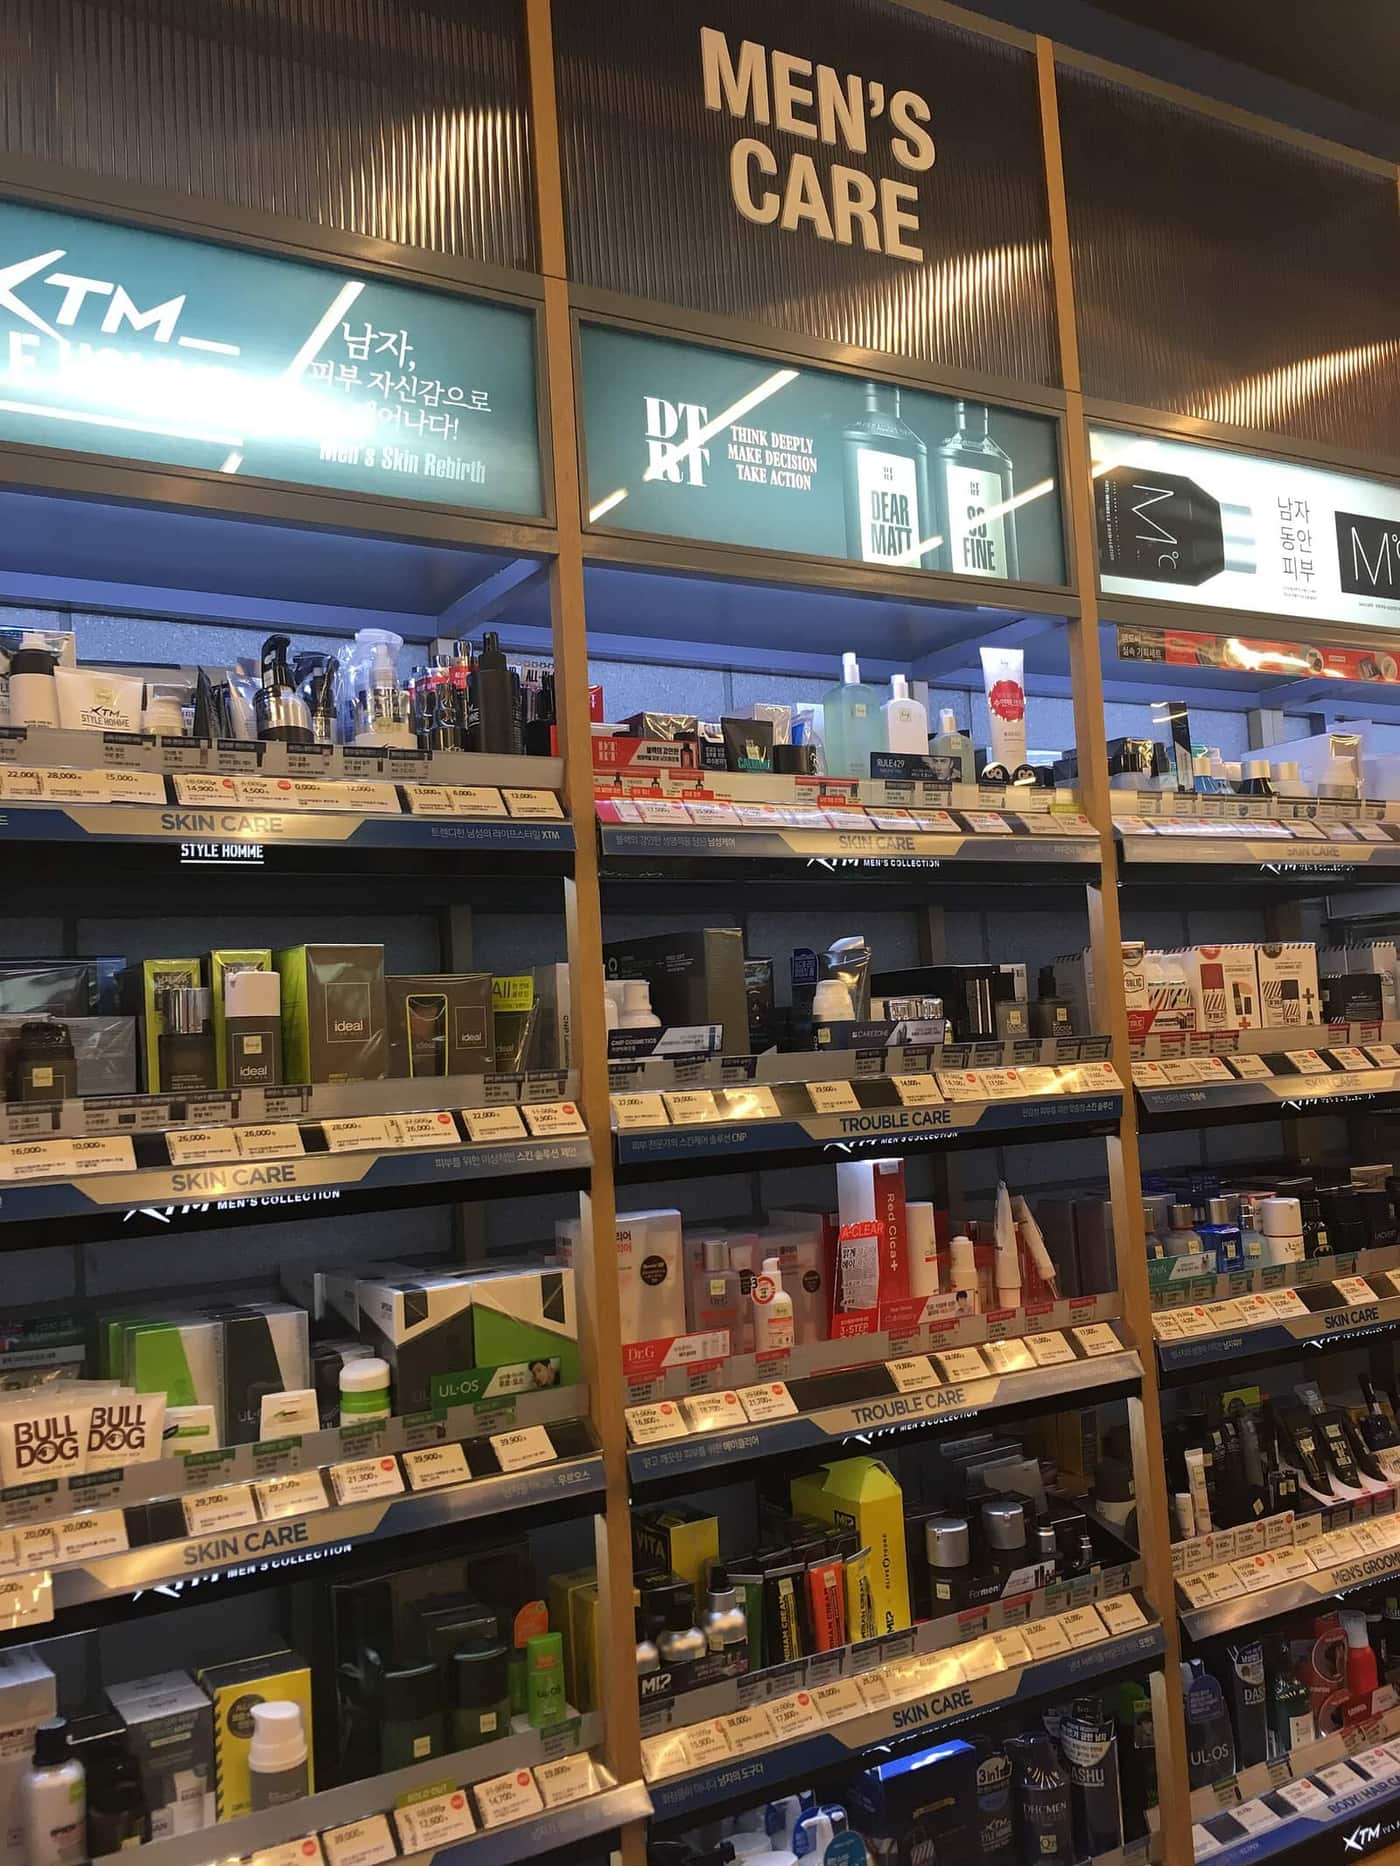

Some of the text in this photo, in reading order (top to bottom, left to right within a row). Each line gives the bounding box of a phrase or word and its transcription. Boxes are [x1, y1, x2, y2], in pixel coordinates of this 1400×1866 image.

[700, 26, 936, 172] MEN'S
[730, 138, 923, 263] CARE
[342, 322, 416, 371] 남자,
[310, 360, 491, 412] 피부 자신감으로
[368, 400, 460, 440] 어나다!
[730, 425, 814, 455] THINK DEEPLY
[381, 446, 419, 474] Skin
[424, 452, 487, 484] Rebirth
[728, 443, 817, 473] MAKE DECISION
[736, 464, 811, 491] TAKE ACTION
[871, 490, 910, 526] DEAR
[1276, 496, 1310, 524] 남자
[871, 523, 913, 557] MATT
[1280, 528, 1313, 554] 동안
[963, 537, 996, 571] FINE
[1282, 556, 1317, 583] 피부
[80, 713, 109, 726] STYLE
[161, 813, 284, 833] SKIN CARE
[467, 827, 491, 840] 남성의
[181, 843, 264, 859] STYLE HOMME
[839, 837, 916, 850] SKIN CARE
[890, 859, 940, 868] COLLECTION
[334, 1019, 363, 1032] ideal
[461, 1031, 482, 1042] ideal
[239, 1065, 268, 1076] ideal
[840, 1110, 951, 1133] TROUBLE CARE
[516, 1150, 533, 1161] 스킨
[172, 1165, 296, 1193] SKIN CARE
[261, 1189, 340, 1207] COLLECTION
[840, 1221, 885, 1240] A-CLEAR
[1324, 1307, 1380, 1330] SKIN CARE
[627, 1346, 655, 1361] Dr.G
[90, 1404, 146, 1428] BULL
[851, 1388, 966, 1426] TROUBLE CARE
[14, 1415, 78, 1446] BULL
[87, 1426, 145, 1452] DOG
[15, 1437, 79, 1468] DOG
[184, 1522, 309, 1566] SKIN CARE
[1331, 1564, 1364, 1585] MEN'S
[893, 1689, 974, 1729] SKIN CARE
[1190, 1744, 1229, 1766] UL·OS
[1070, 1767, 1105, 1783] ASHU
[1342, 1820, 1381, 1851] XTM
